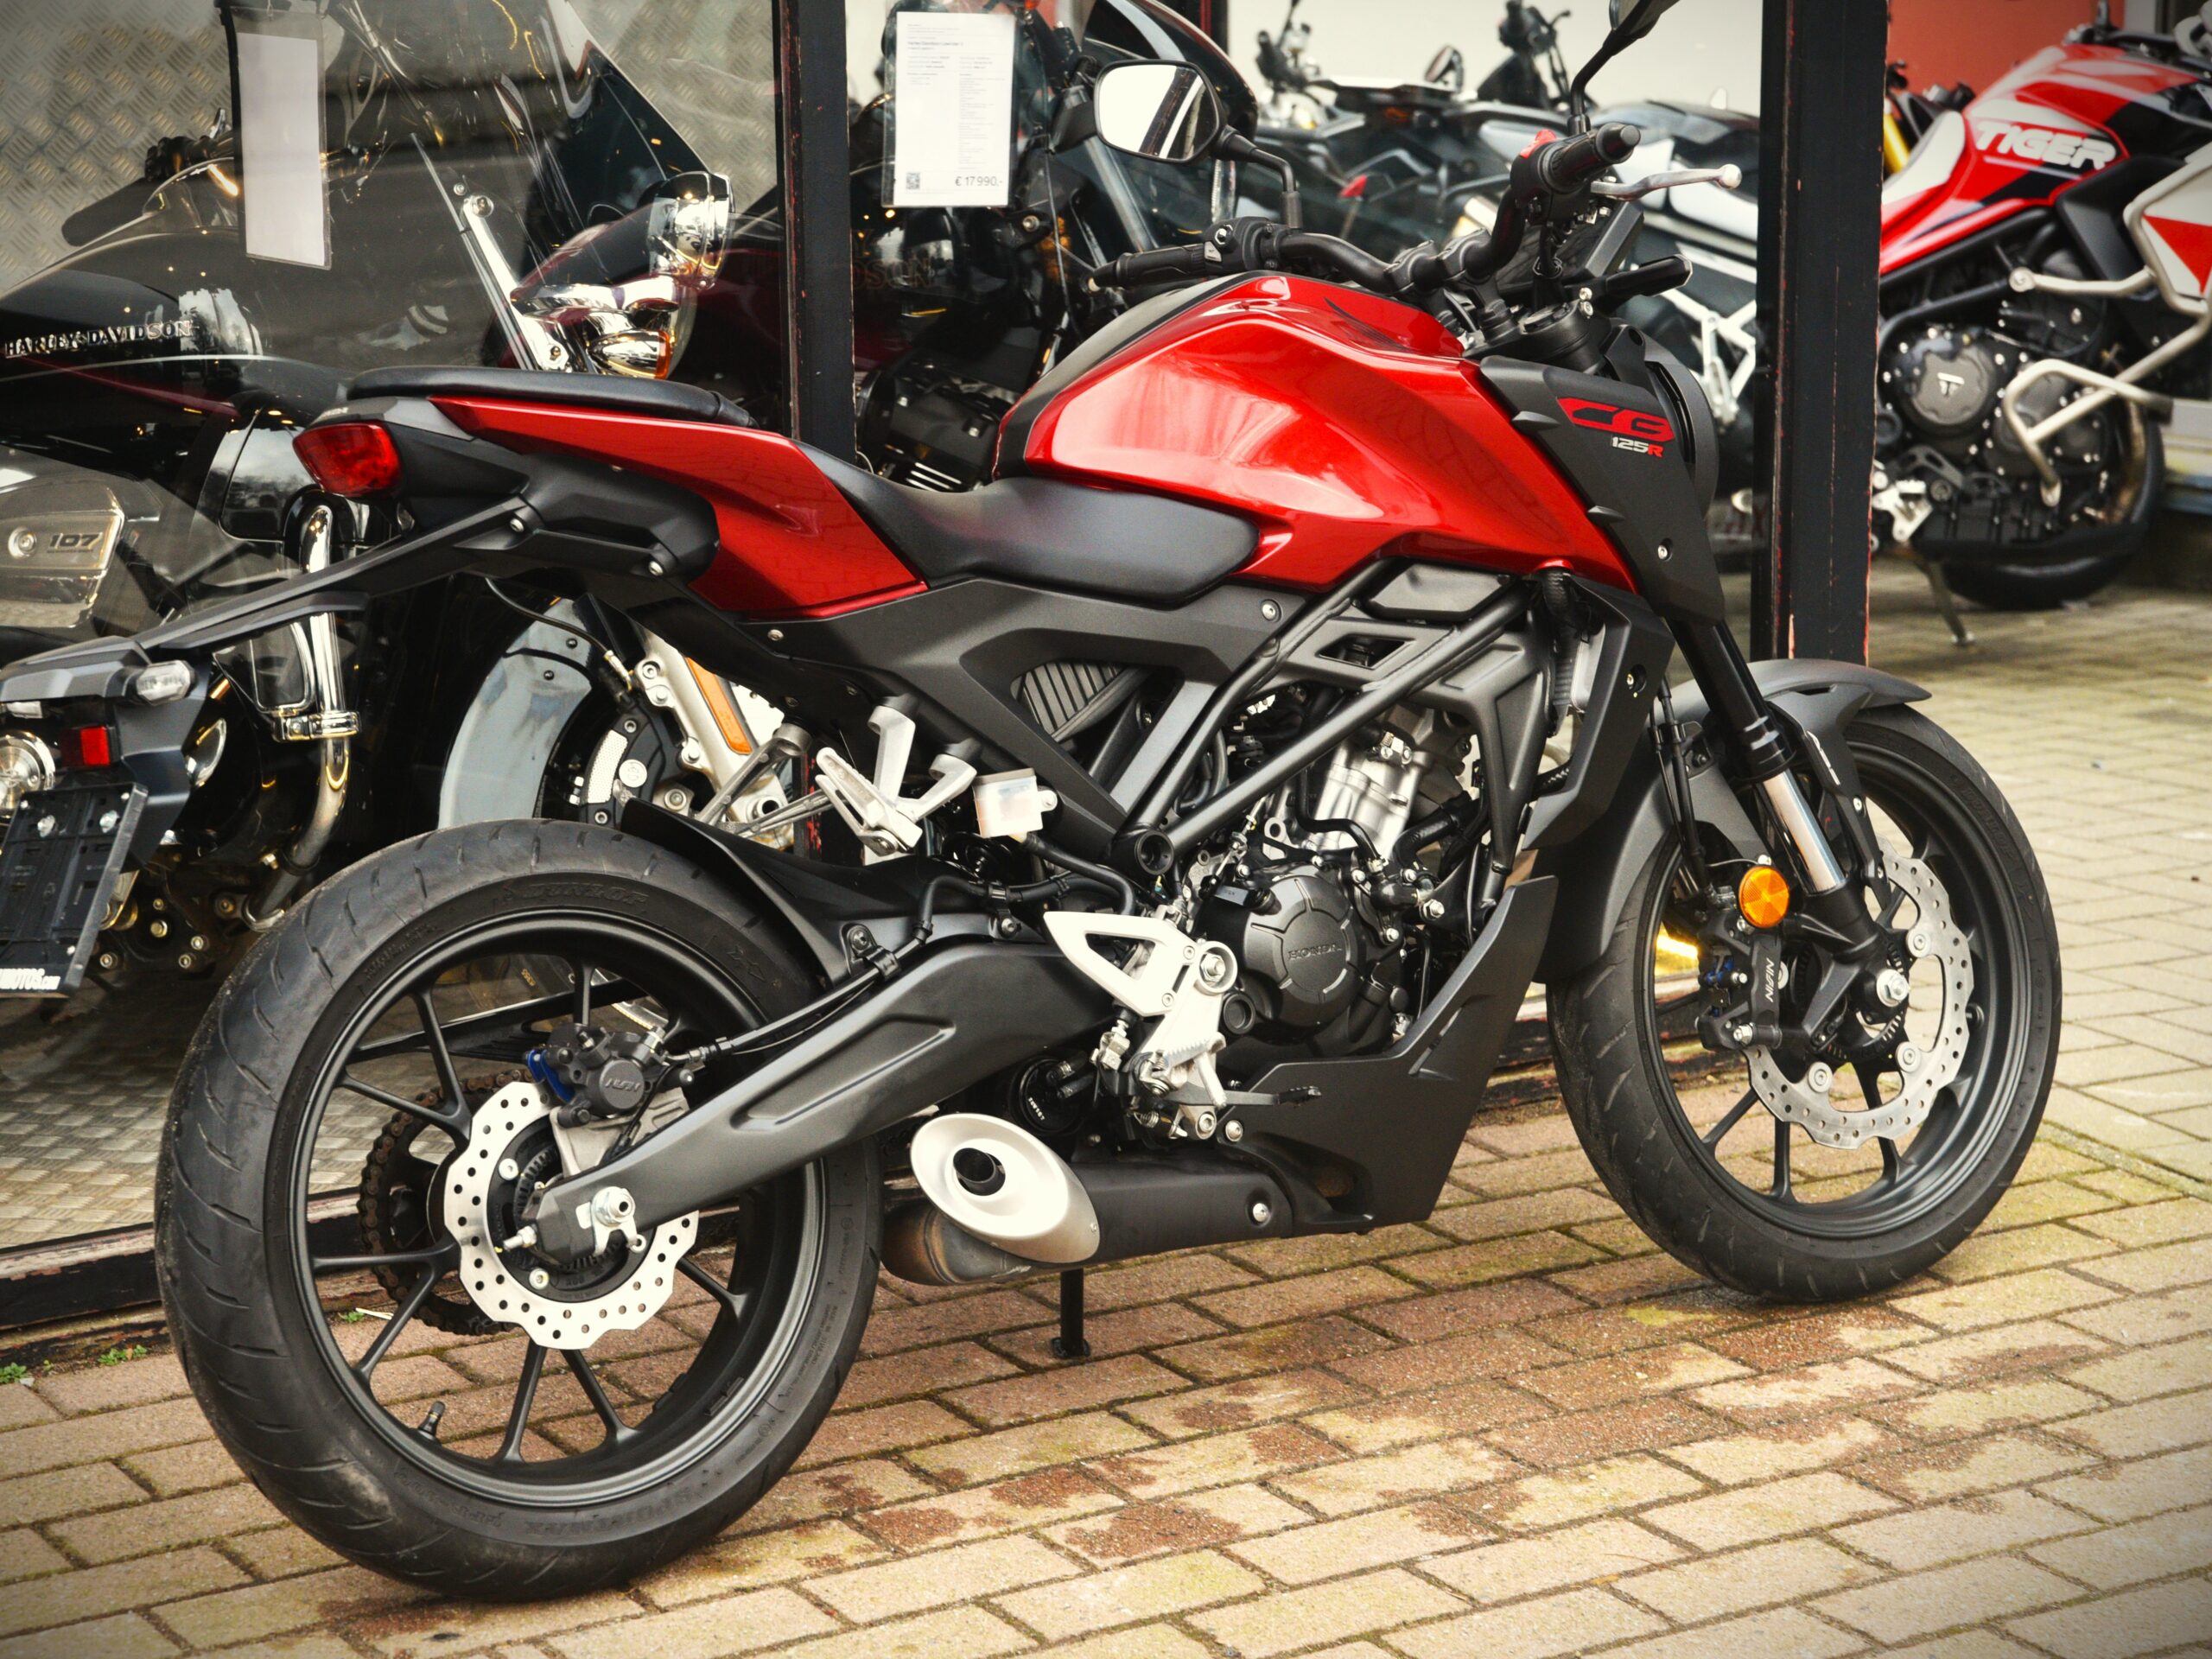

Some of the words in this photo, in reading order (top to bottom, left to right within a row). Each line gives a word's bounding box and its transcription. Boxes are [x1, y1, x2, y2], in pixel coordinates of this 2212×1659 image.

[1975, 121, 2116, 170] TIGER
[1611, 436, 1664, 458] 125R
[49, 532, 104, 550] 107
[1287, 943, 1343, 961] HONDA
